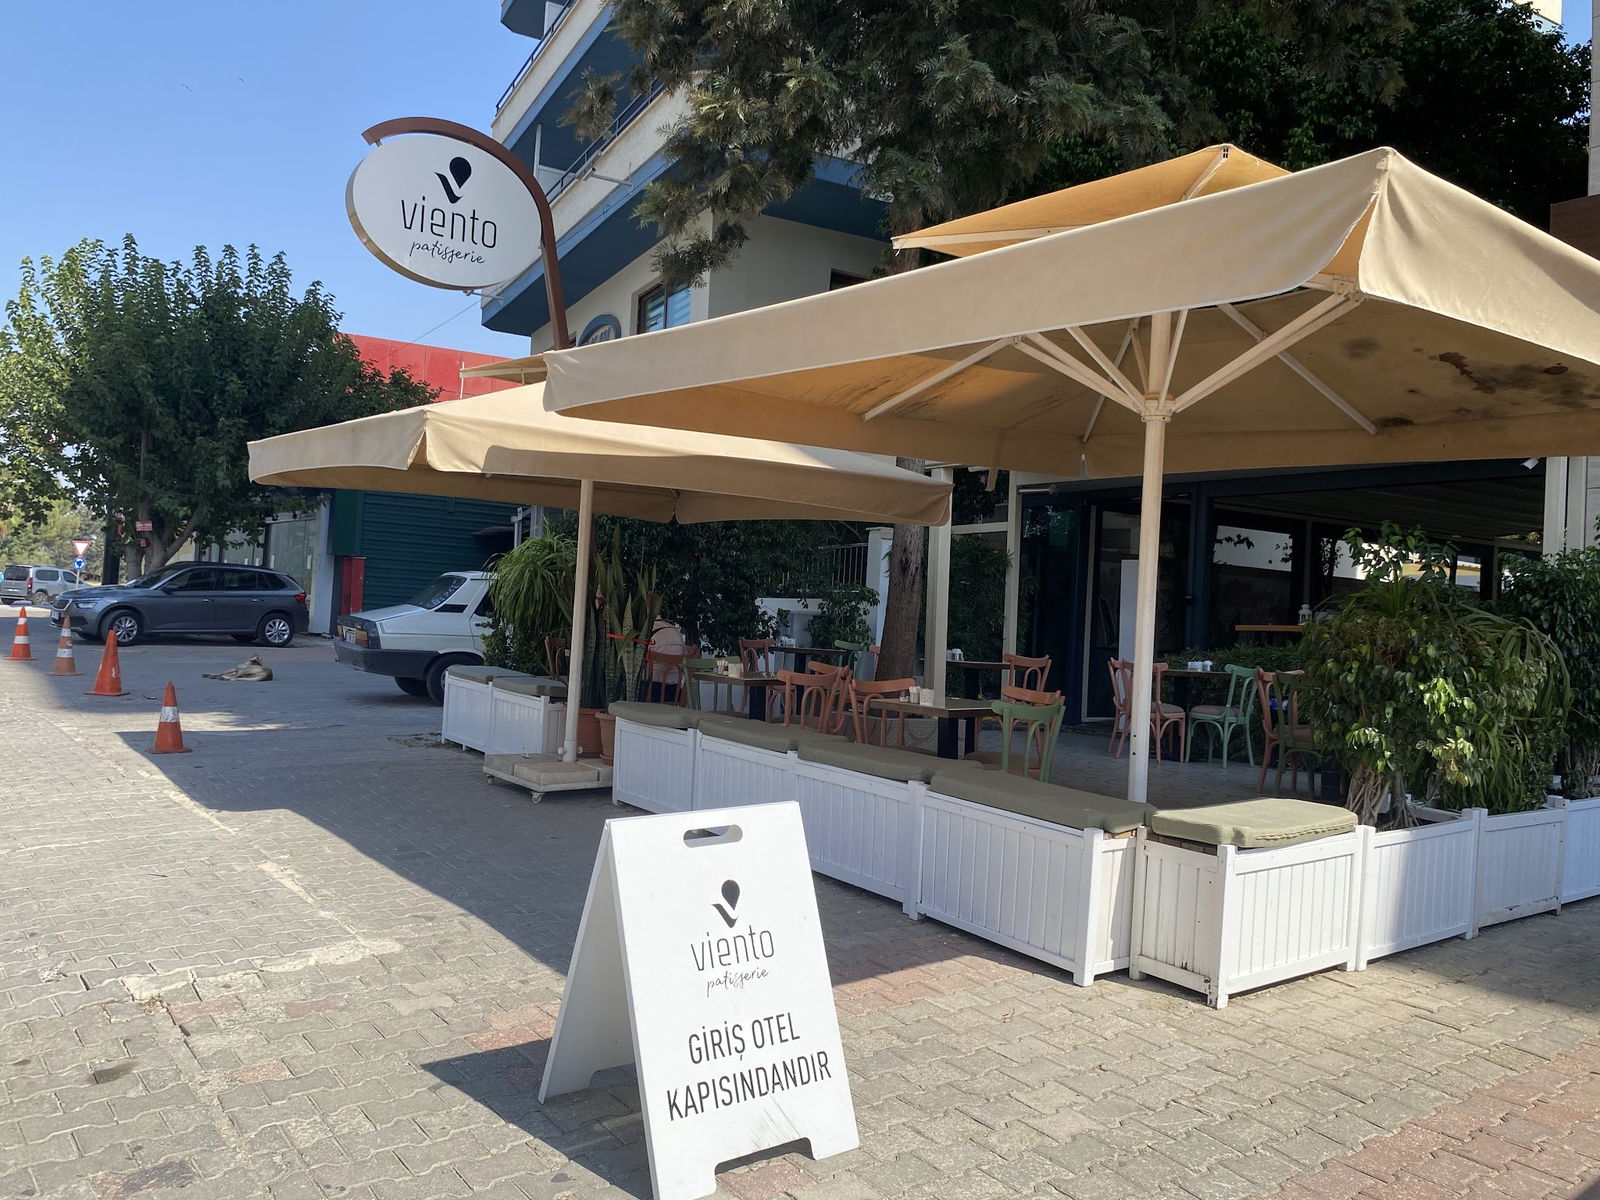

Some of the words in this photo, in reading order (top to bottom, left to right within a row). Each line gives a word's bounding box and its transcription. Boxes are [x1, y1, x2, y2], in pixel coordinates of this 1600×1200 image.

[401, 195, 498, 249] viento
[409, 240, 486, 264] patisserie
[690, 925, 775, 972] viento
[706, 966, 770, 998] patisserie
[688, 1020, 746, 1065] GİRİŞ
[751, 1012, 801, 1049] OTEL
[666, 1050, 832, 1122] KAPISINDANDIR
